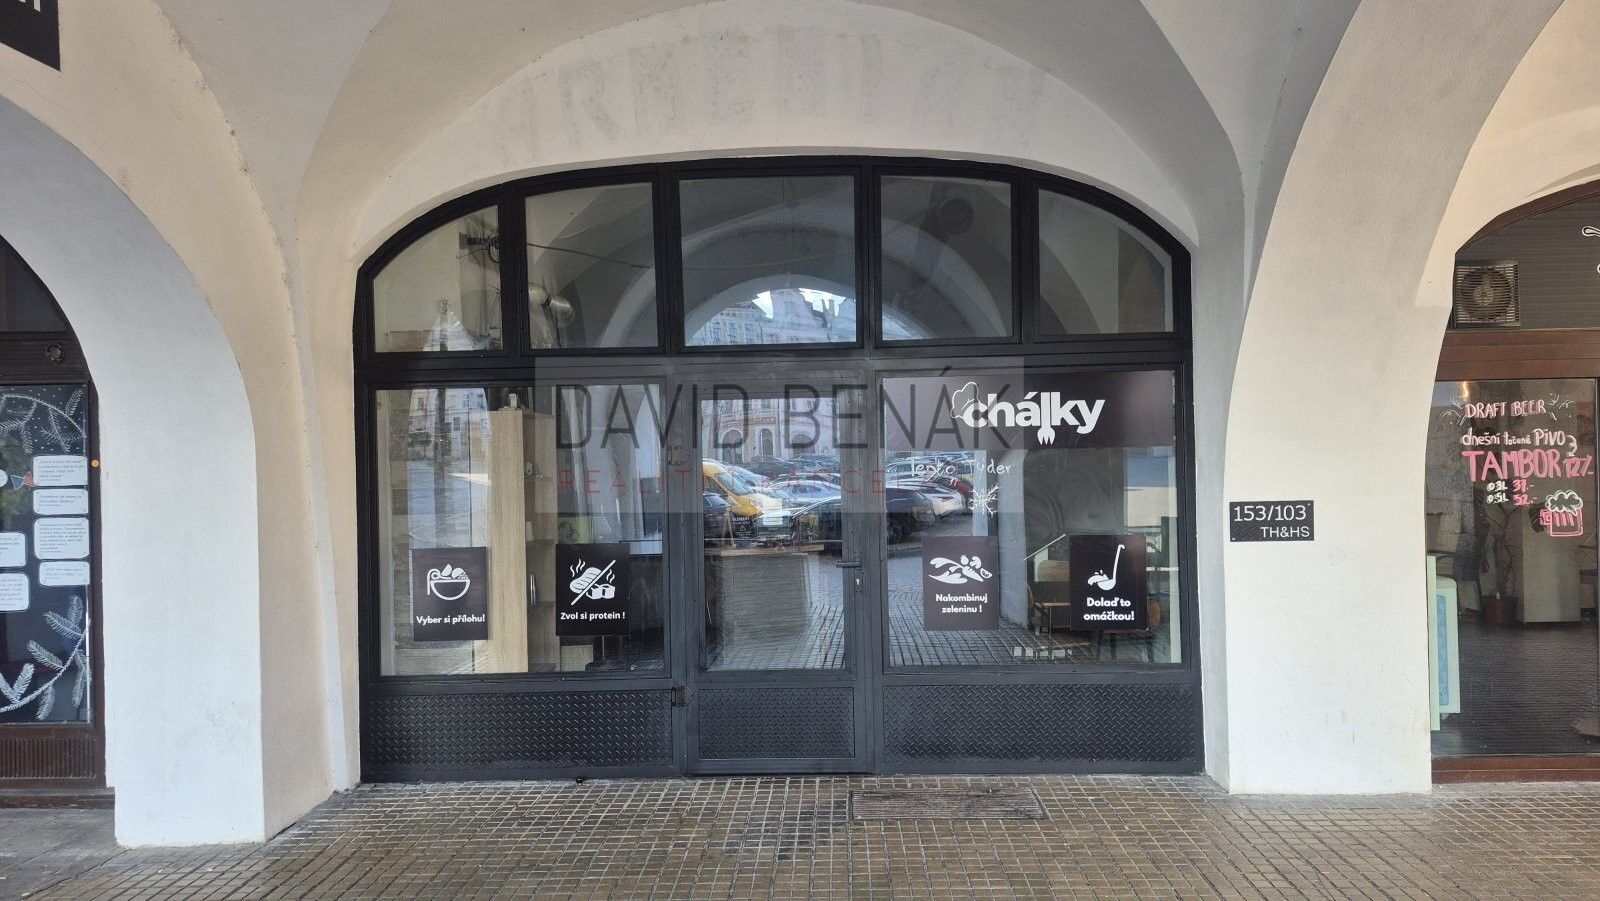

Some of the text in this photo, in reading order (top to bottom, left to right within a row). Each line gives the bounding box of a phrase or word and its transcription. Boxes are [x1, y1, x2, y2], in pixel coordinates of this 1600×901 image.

[1465, 399, 1547, 419] DRAFT BEER
[1462, 427, 1500, 446] dnešní
[1461, 448, 1562, 482] TAMBOR
[1233, 505, 1307, 521] 153/103
[1260, 526, 1310, 538] TH&HS
[935, 593, 988, 605] Nakombinuj
[1086, 597, 1131, 608] Dolaď to
[941, 605, 976, 614] zeleninu
[1083, 609, 1135, 622] omáčkou!
[416, 613, 486, 626] Vyber si přílohu!
[560, 611, 578, 620] Zvol
[580, 611, 588, 620] si
[589, 611, 620, 623] protein
